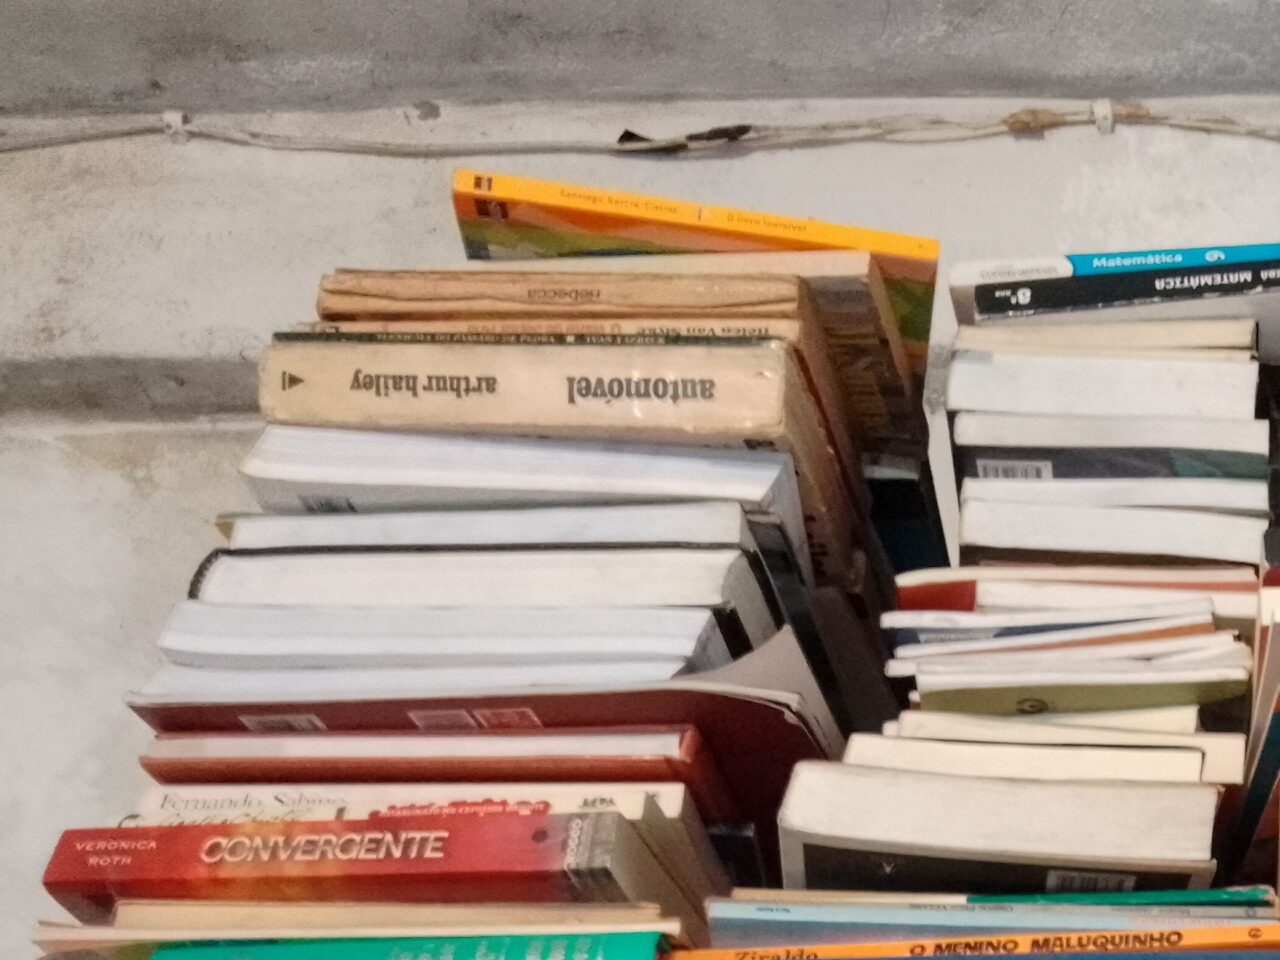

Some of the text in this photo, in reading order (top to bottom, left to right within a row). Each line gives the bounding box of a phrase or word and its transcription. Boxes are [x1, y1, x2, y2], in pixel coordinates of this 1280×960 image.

[1155, 270, 1253, 292] MATEMÁTICA
[350, 368, 716, 408] automóvel arthur hailey
[75, 839, 158, 852] VERONICA
[200, 828, 449, 864] CONVERGENTE
[88, 855, 132, 867] ROTH
[909, 930, 1185, 957] O MENINO MALUQUINHO
